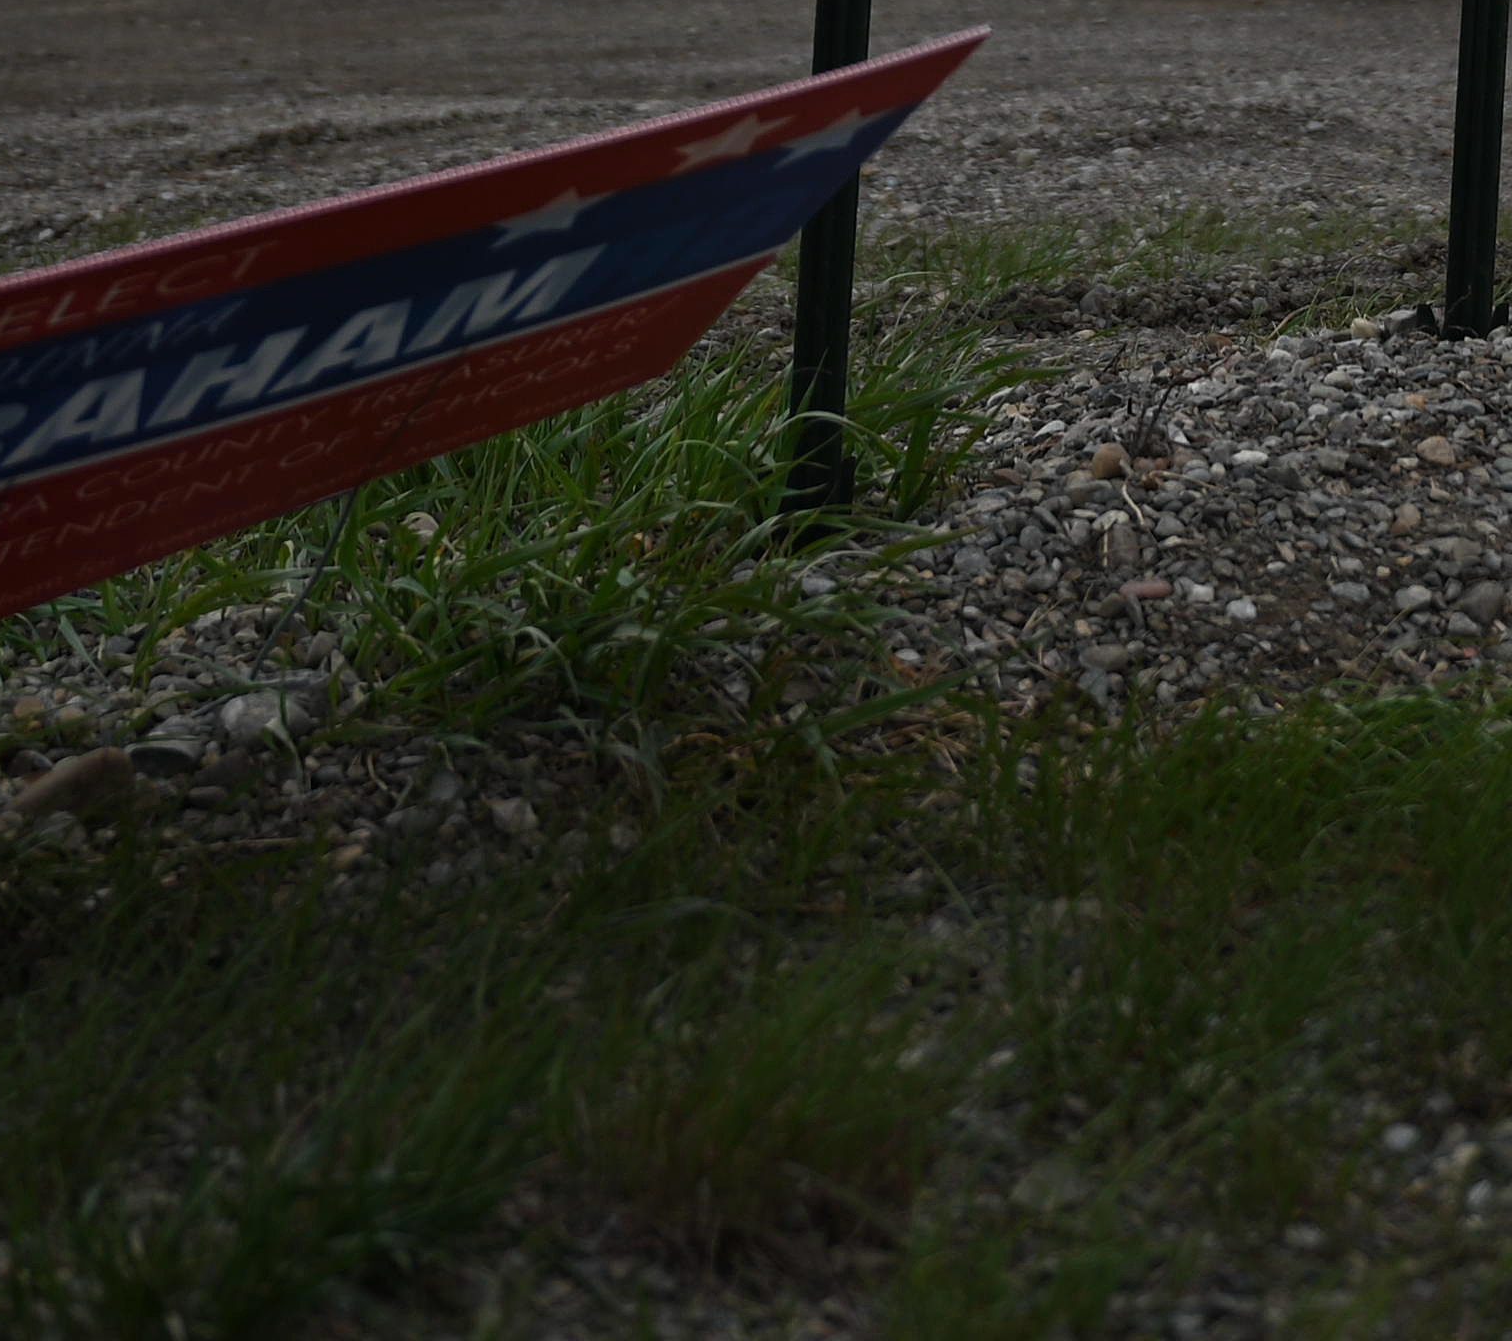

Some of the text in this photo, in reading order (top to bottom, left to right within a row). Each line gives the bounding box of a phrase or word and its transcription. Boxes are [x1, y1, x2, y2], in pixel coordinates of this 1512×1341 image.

[73, 400, 331, 503] COUNTY
[279, 429, 356, 470] OF
[373, 335, 640, 437] SCHOOLS
